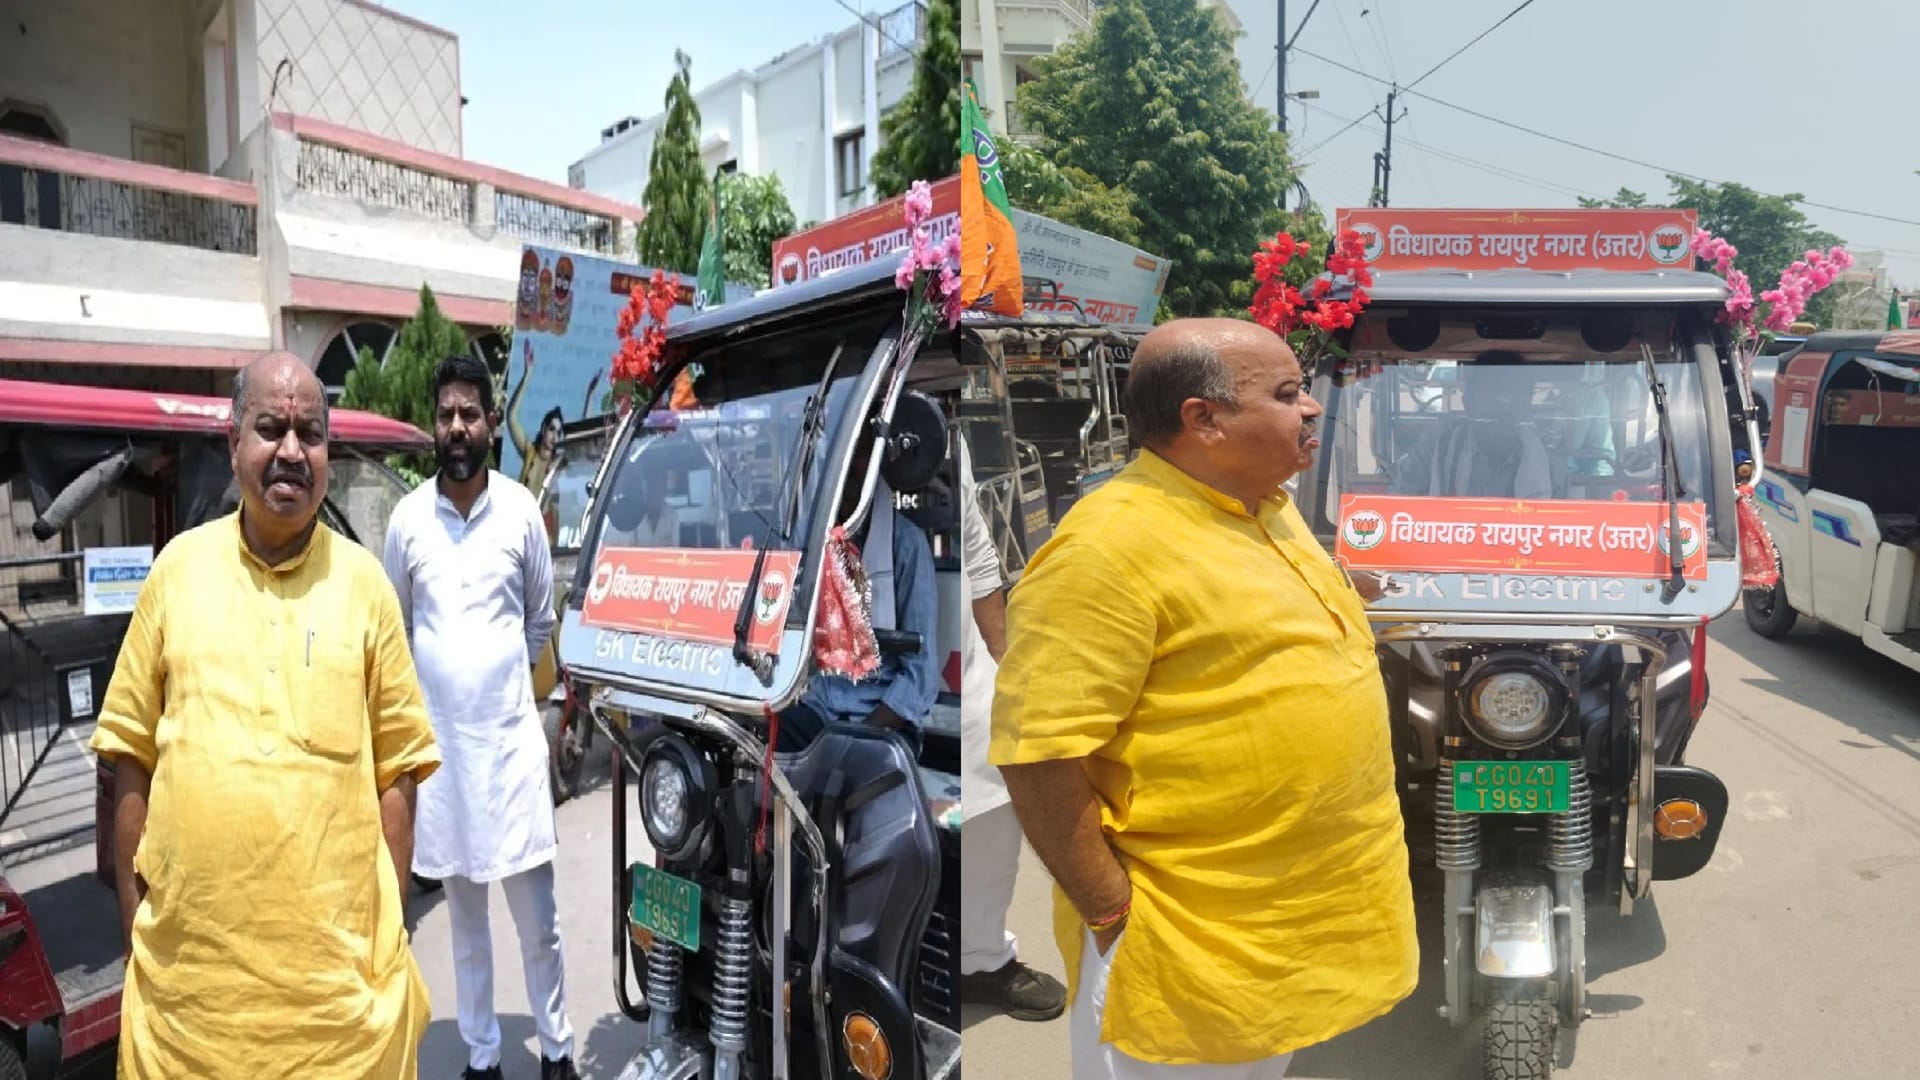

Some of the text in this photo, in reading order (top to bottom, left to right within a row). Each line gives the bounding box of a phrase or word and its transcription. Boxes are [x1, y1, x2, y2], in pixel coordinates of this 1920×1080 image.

[1388, 225, 1646, 264] विधायक रायपुर नगर (उत्तर)
[1390, 512, 1654, 555] विधायक रायपुर नगर (उत्तर)
[610, 564, 655, 600] विधायक
[654, 576, 691, 614] रायपुर
[690, 579, 719, 608] नगर
[1462, 573, 1626, 601] Electric
[631, 636, 724, 676] Electric
[1475, 788, 1553, 810] T9691
